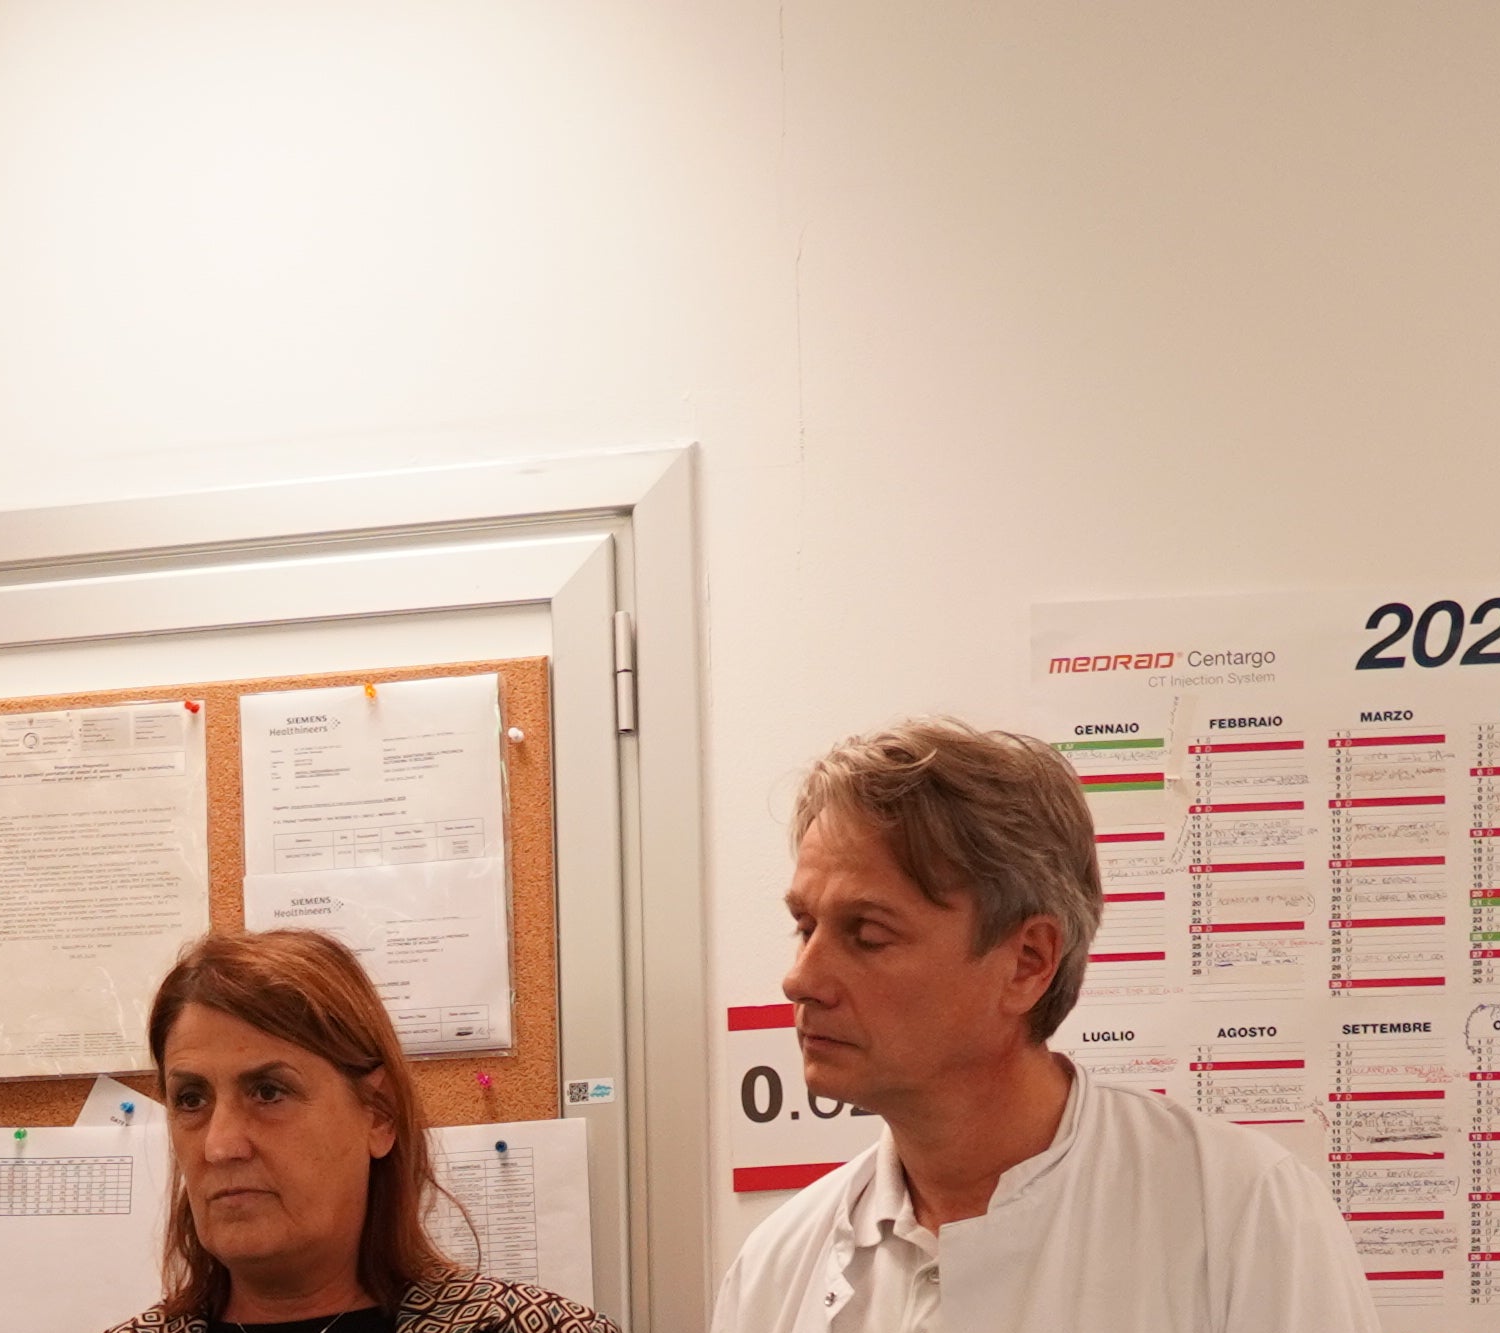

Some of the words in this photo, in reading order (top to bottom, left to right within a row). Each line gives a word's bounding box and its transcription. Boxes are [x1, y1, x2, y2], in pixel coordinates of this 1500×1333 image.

[1187, 650, 1276, 668] Centargo
[1148, 676, 1166, 688] CT
[1170, 671, 1224, 687] Injection
[1227, 671, 1276, 686] System
[286, 714, 328, 725] SIEMENS
[1209, 716, 1283, 729] FEBBRAIO
[1360, 710, 1414, 723] MARZO
[269, 725, 328, 737] Healthineers
[1074, 722, 1139, 736] GENNAIO
[291, 896, 331, 907] SIEMENS
[273, 906, 332, 919] Healthineers
[1217, 1026, 1278, 1039] AGOSTO
[1342, 1021, 1432, 1035] SETTEMBRE
[1082, 1030, 1135, 1042] LUGLIO
